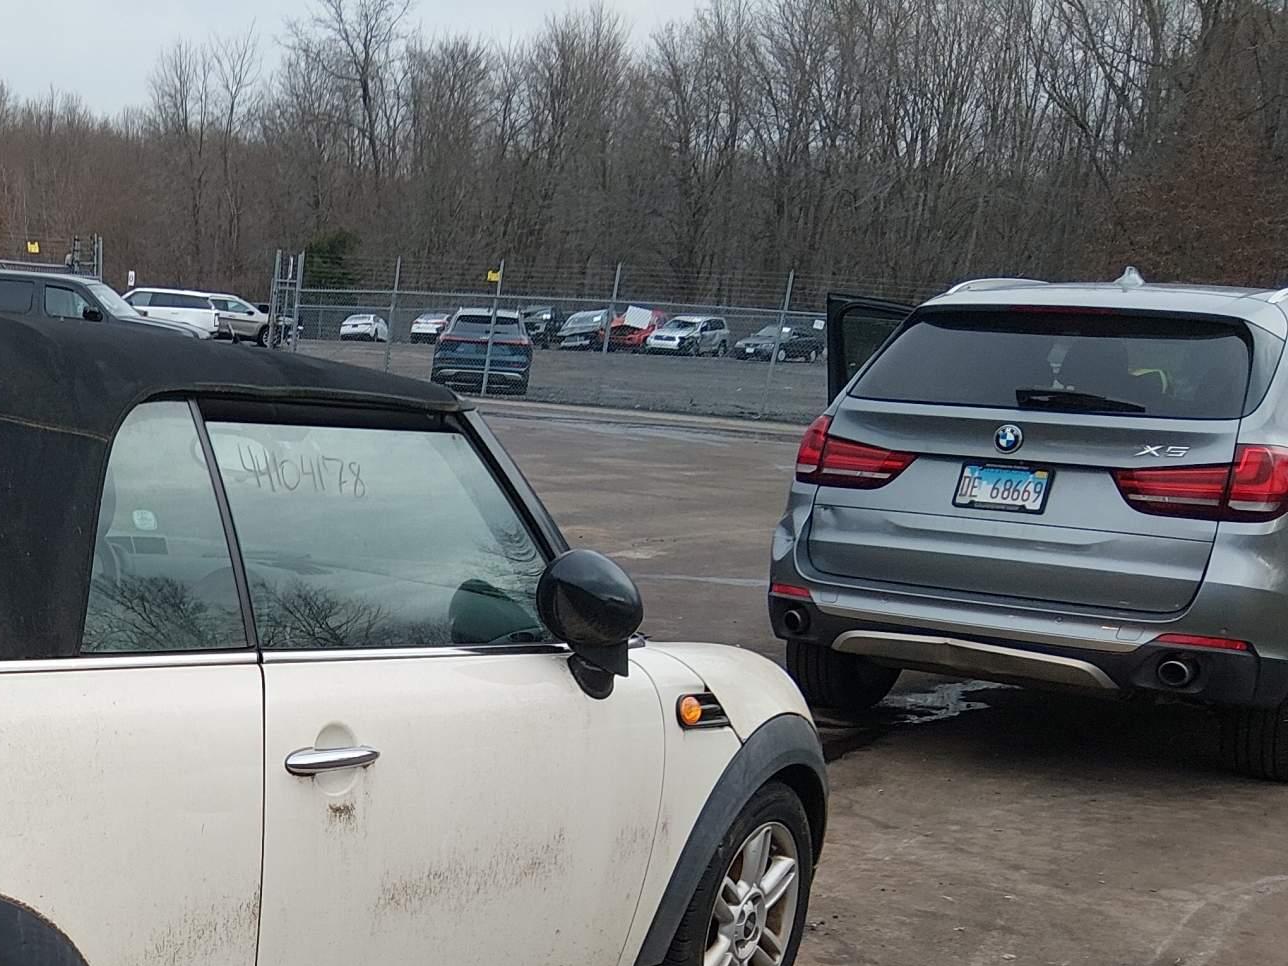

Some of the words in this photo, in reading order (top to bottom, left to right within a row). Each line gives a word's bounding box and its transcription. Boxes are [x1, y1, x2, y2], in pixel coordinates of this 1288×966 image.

[1134, 444, 1191, 457] X5
[237, 443, 365, 498] 44104178
[958, 475, 982, 498] DE
[990, 478, 1044, 504] 68669
